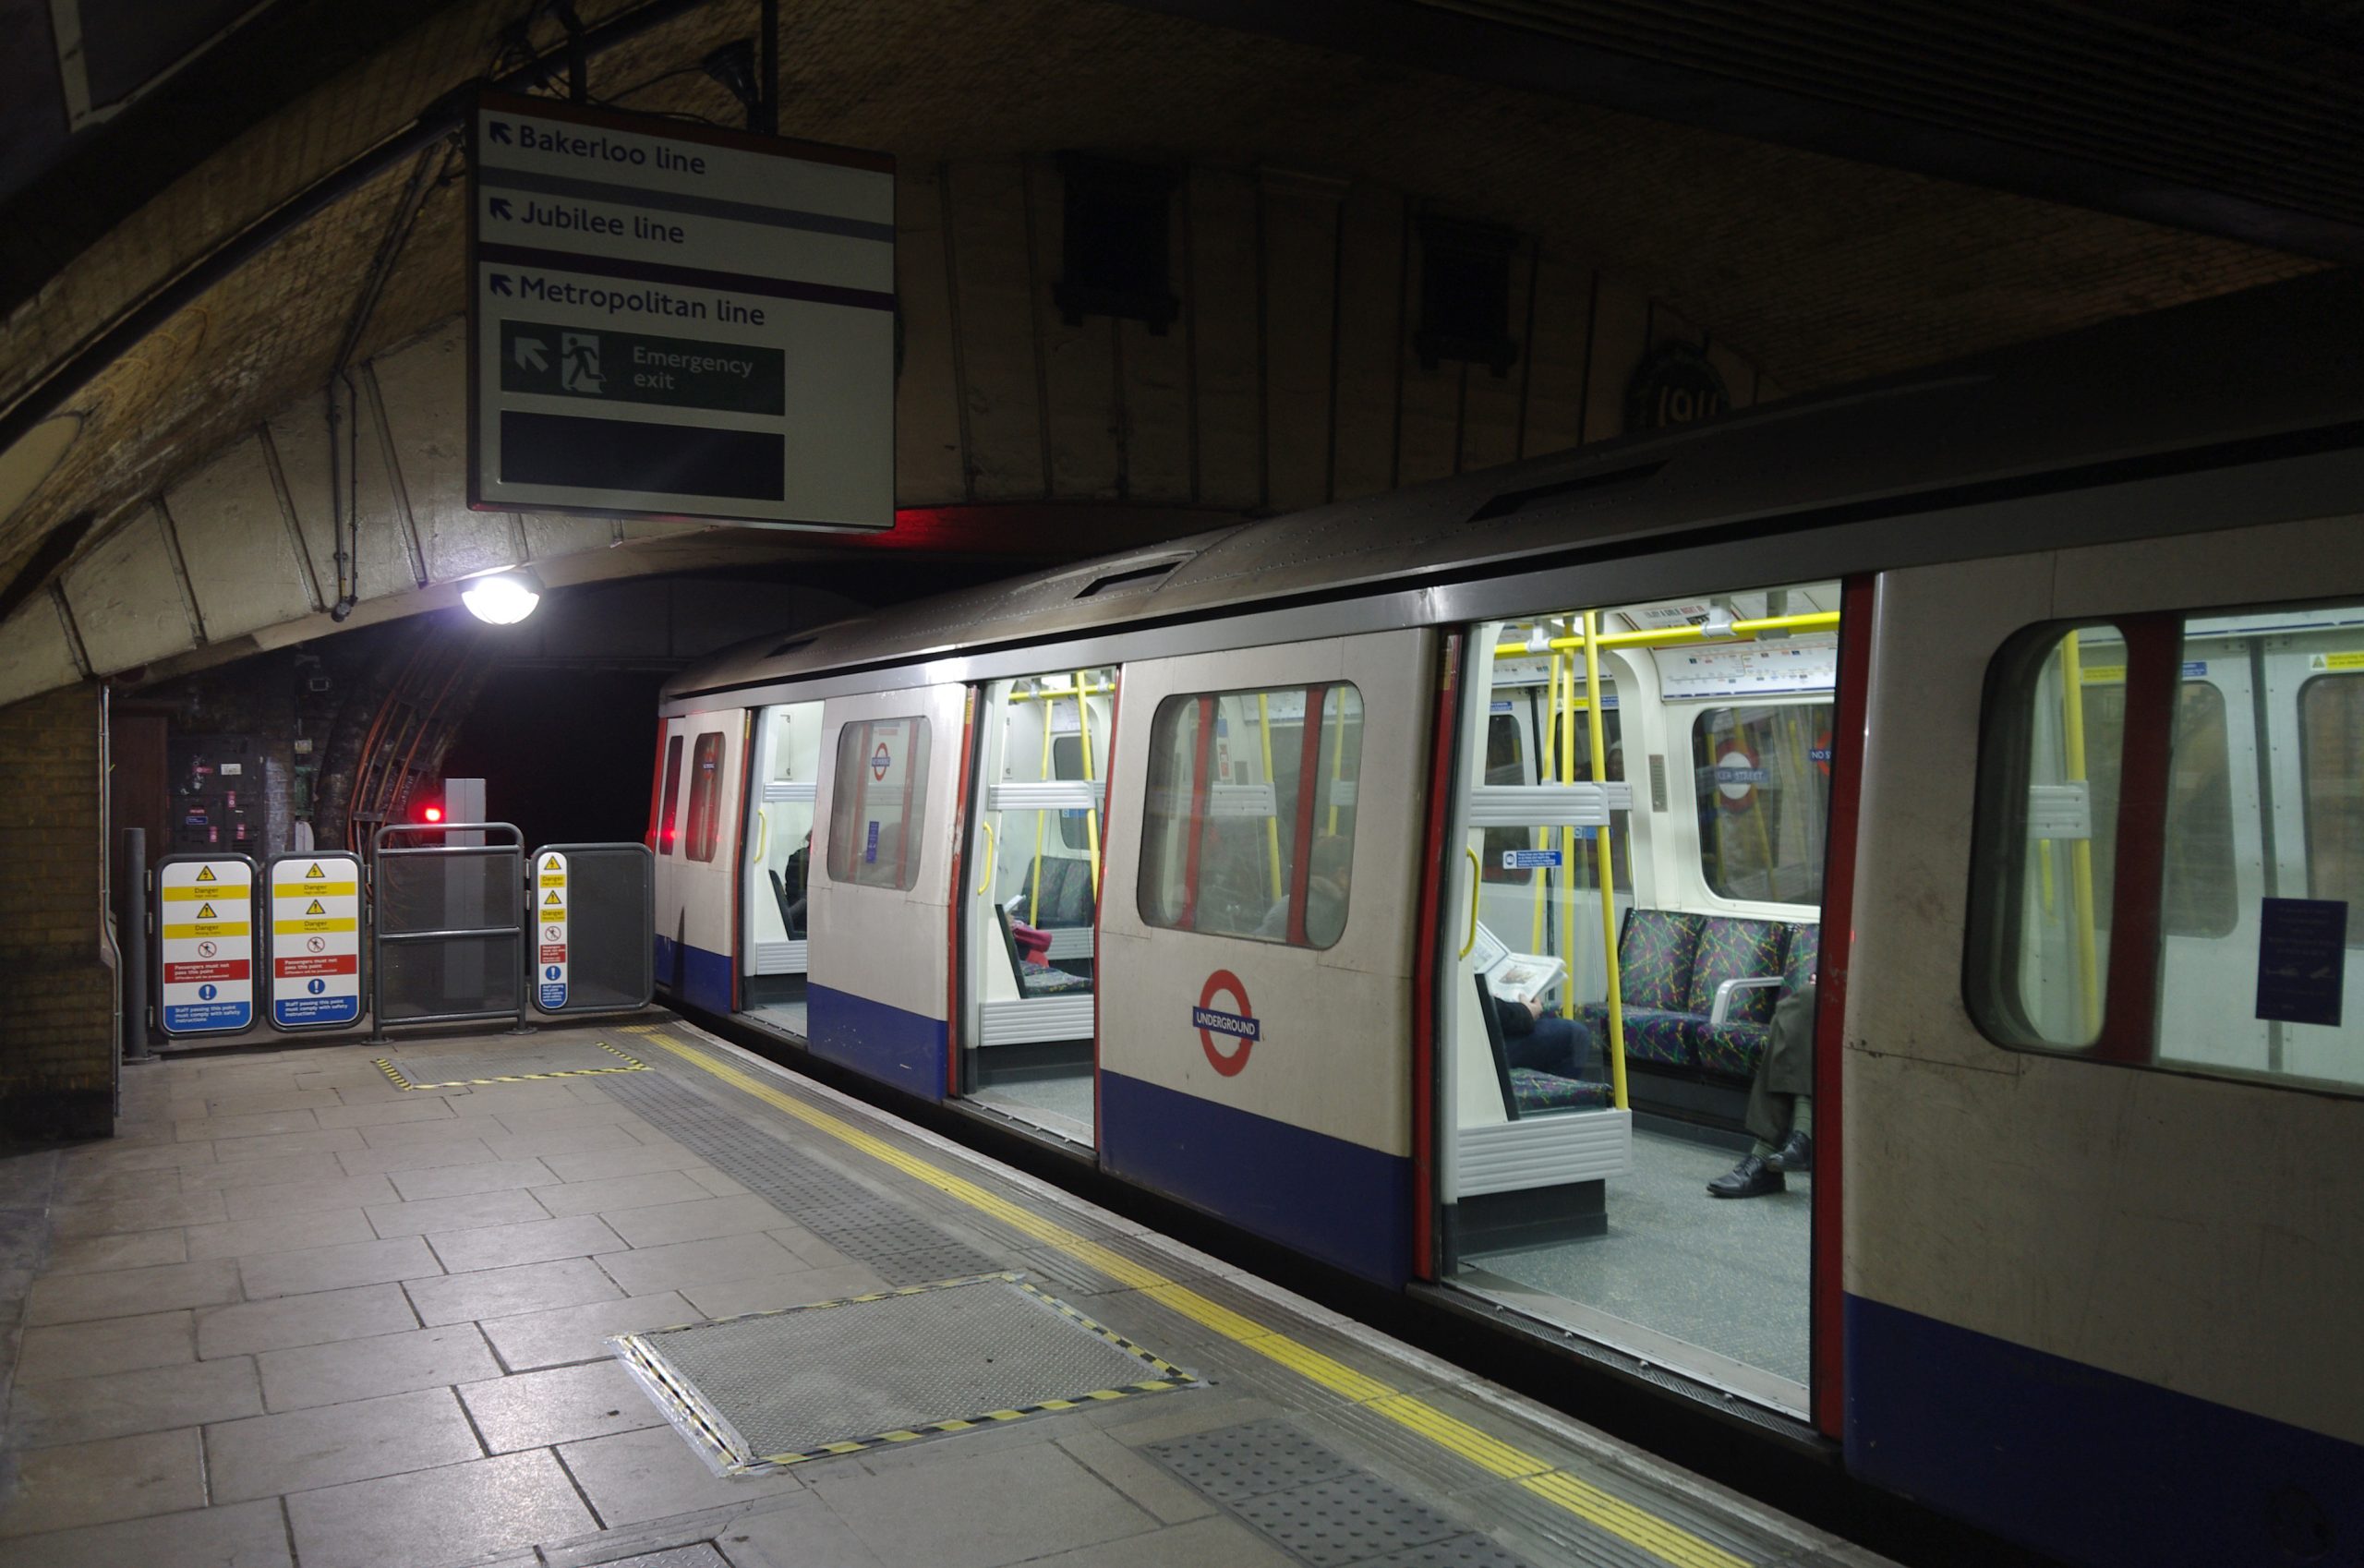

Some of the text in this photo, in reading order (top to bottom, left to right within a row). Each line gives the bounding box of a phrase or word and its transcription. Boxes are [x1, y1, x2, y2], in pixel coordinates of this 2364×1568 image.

[519, 125, 706, 175] Bakerloo line
[521, 201, 685, 243] Jubilee line
[520, 277, 766, 326] Metropolitan line
[633, 346, 754, 391] Emergency exit
[1196, 1011, 1255, 1035] UNDERGROUND
